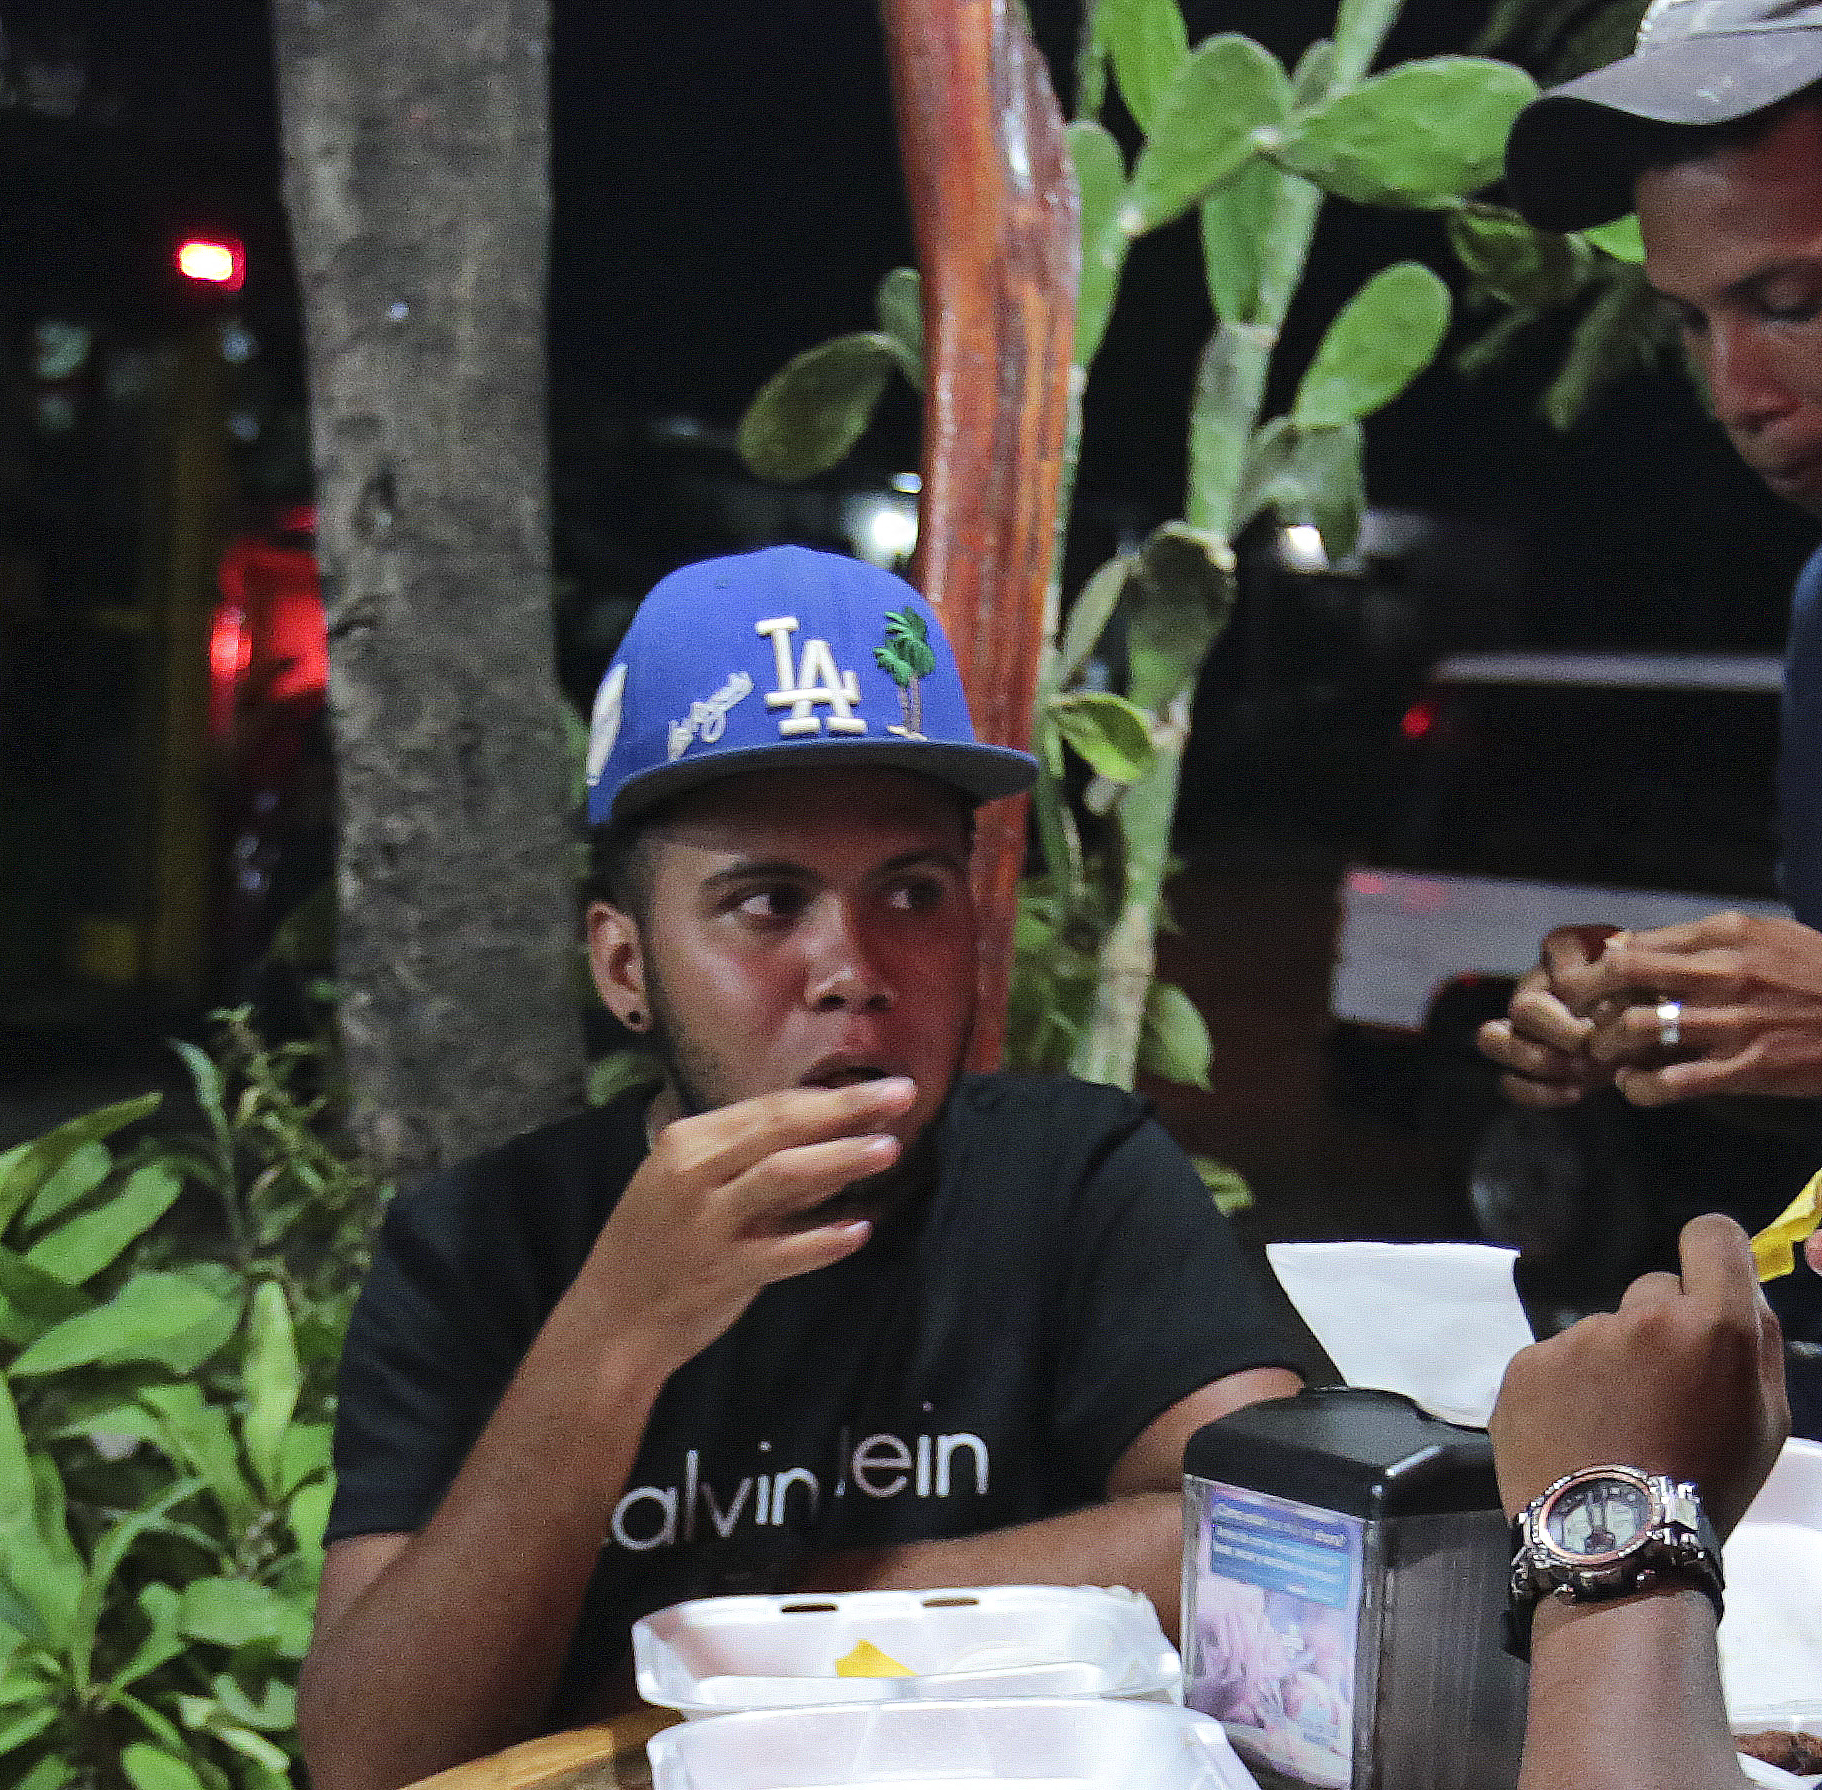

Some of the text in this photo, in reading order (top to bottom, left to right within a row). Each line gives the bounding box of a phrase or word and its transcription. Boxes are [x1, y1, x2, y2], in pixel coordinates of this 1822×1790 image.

[754, 615, 868, 736] LA
[607, 1401, 990, 1551] alvin lein
